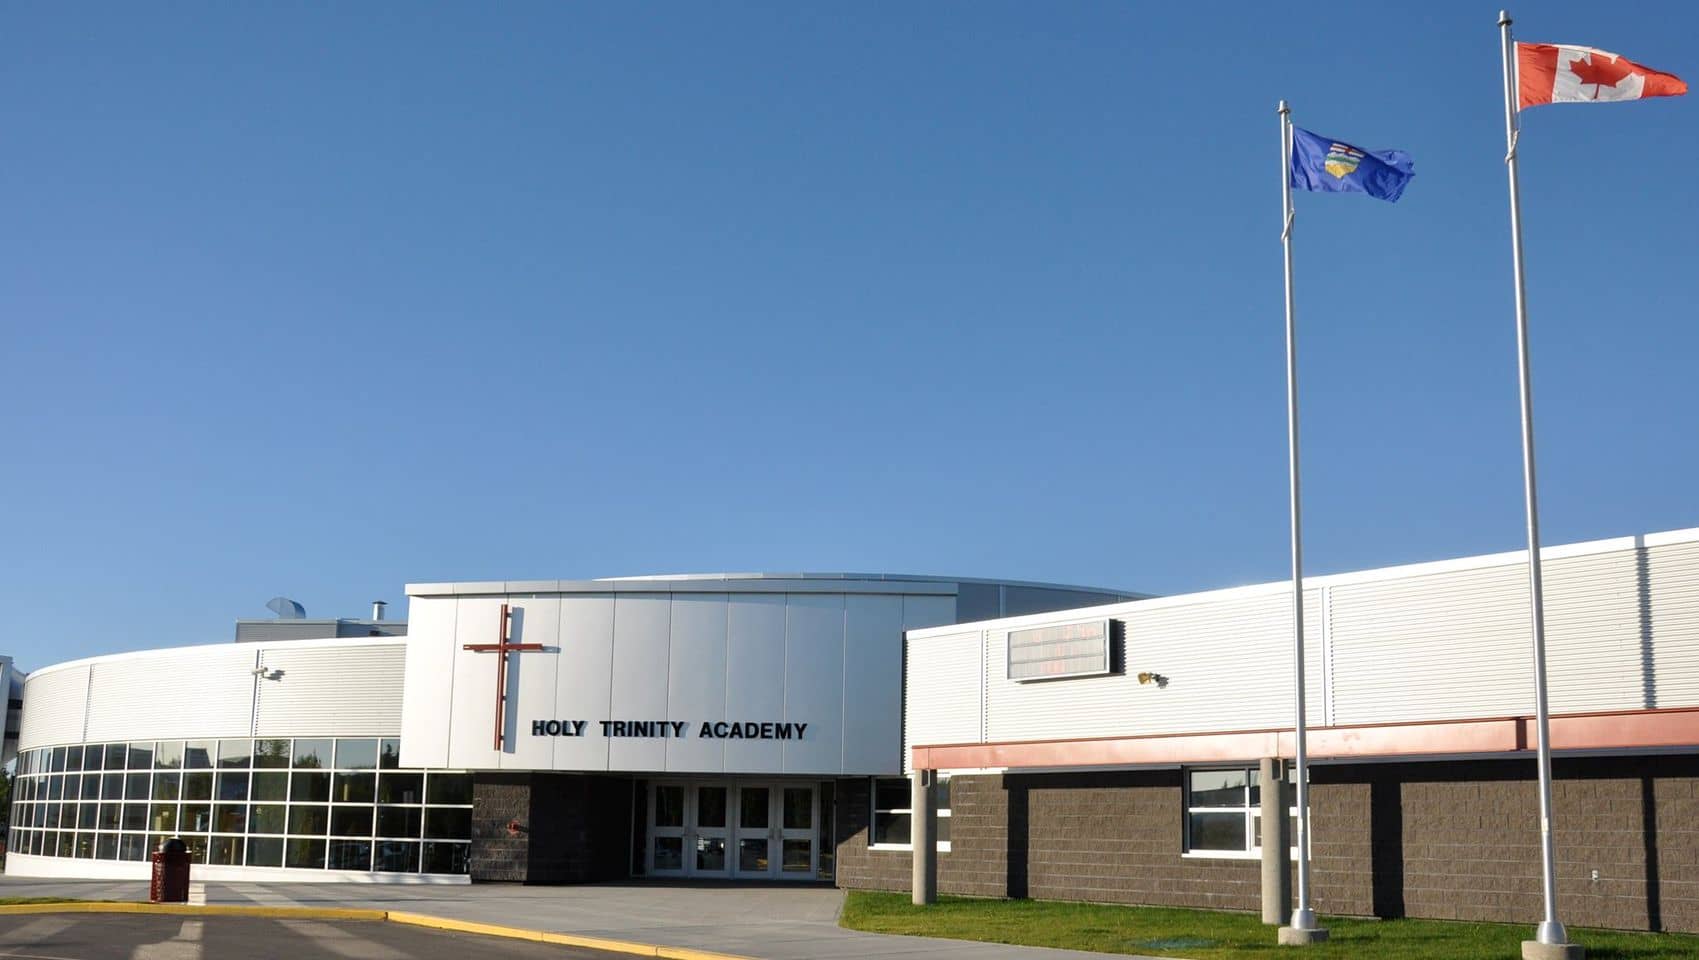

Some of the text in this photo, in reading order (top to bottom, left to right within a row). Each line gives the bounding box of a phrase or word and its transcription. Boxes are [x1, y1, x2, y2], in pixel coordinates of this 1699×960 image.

[532, 720, 808, 740] HOLY TRINITY ACADEMY
